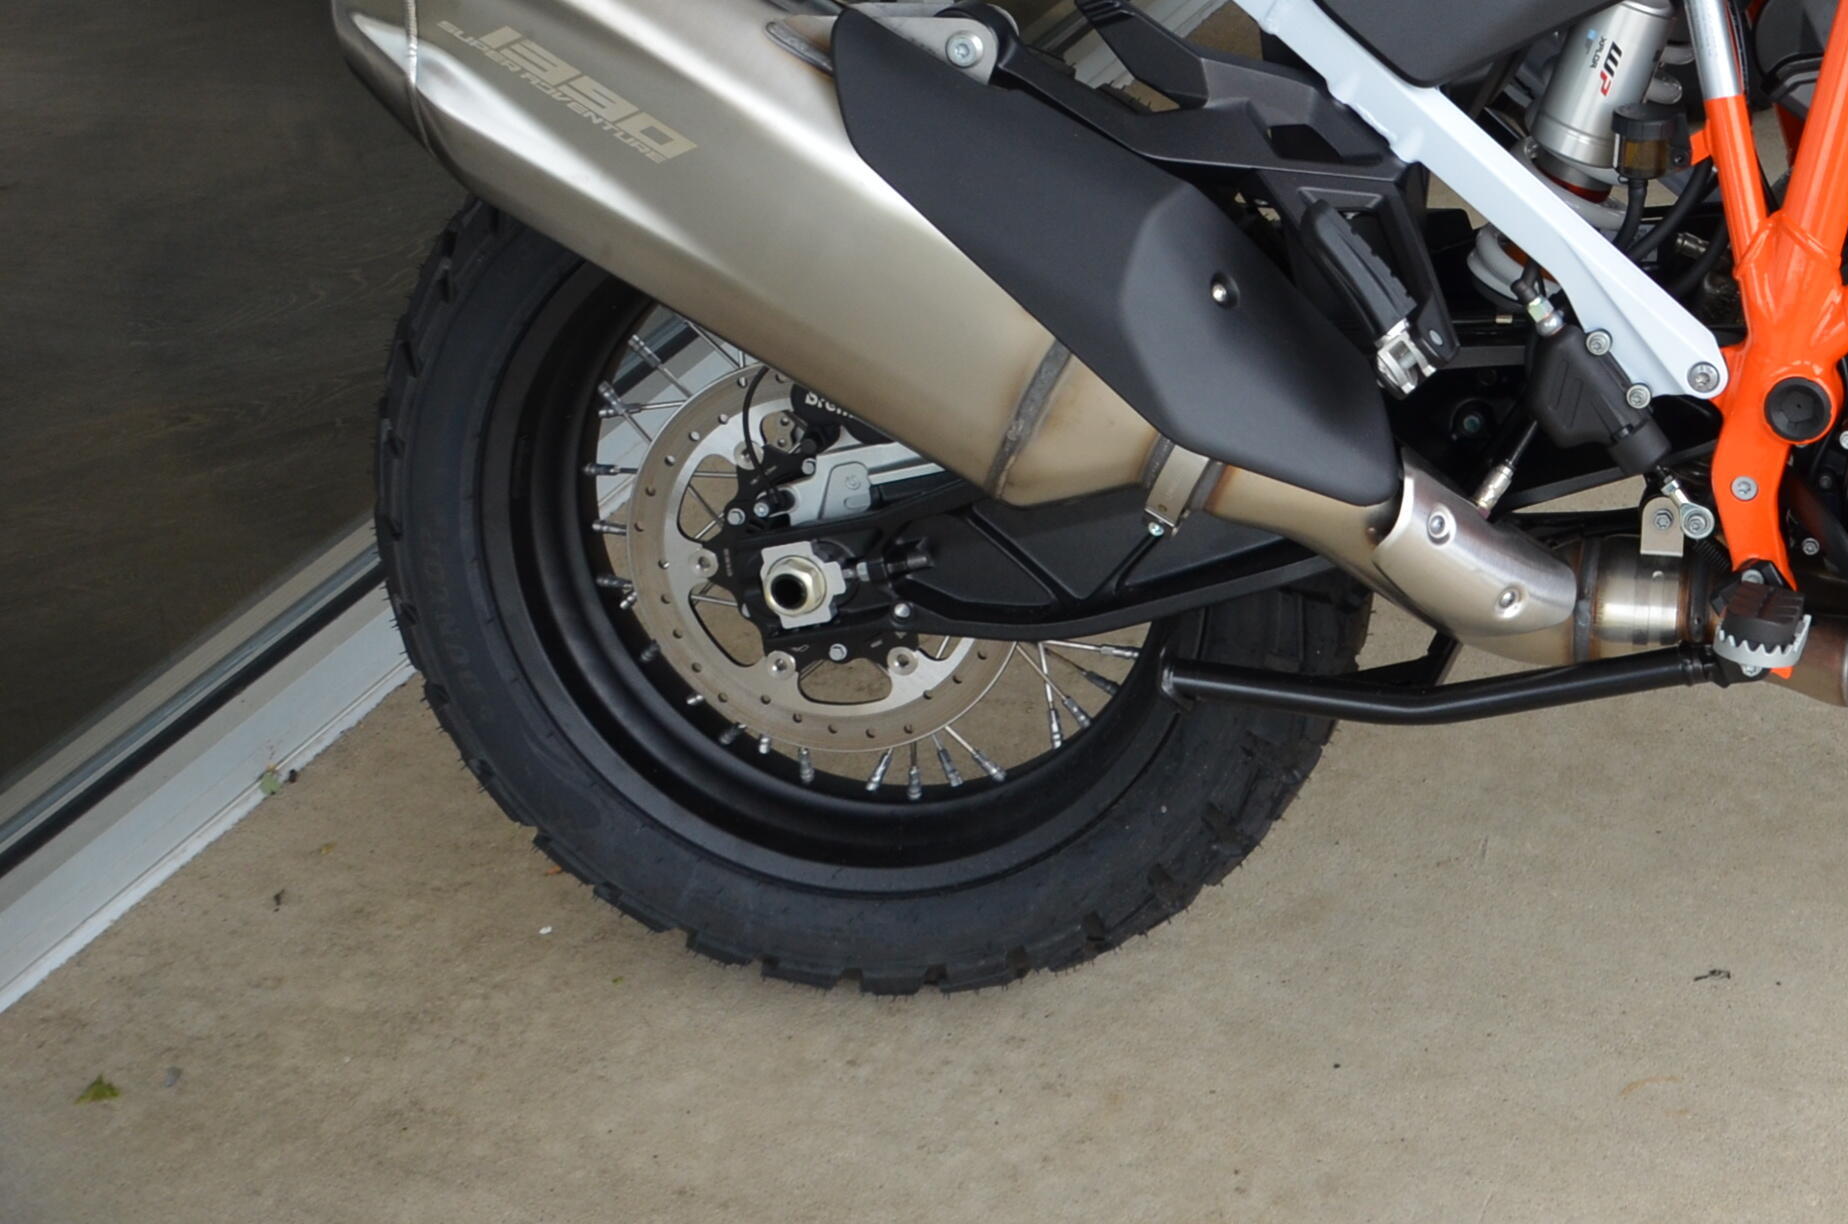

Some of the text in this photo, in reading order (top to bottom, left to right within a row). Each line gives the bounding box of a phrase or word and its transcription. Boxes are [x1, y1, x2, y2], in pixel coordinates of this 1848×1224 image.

[437, 20, 668, 165] SUPER ADVENTURE
[478, 26, 697, 159] 1390
